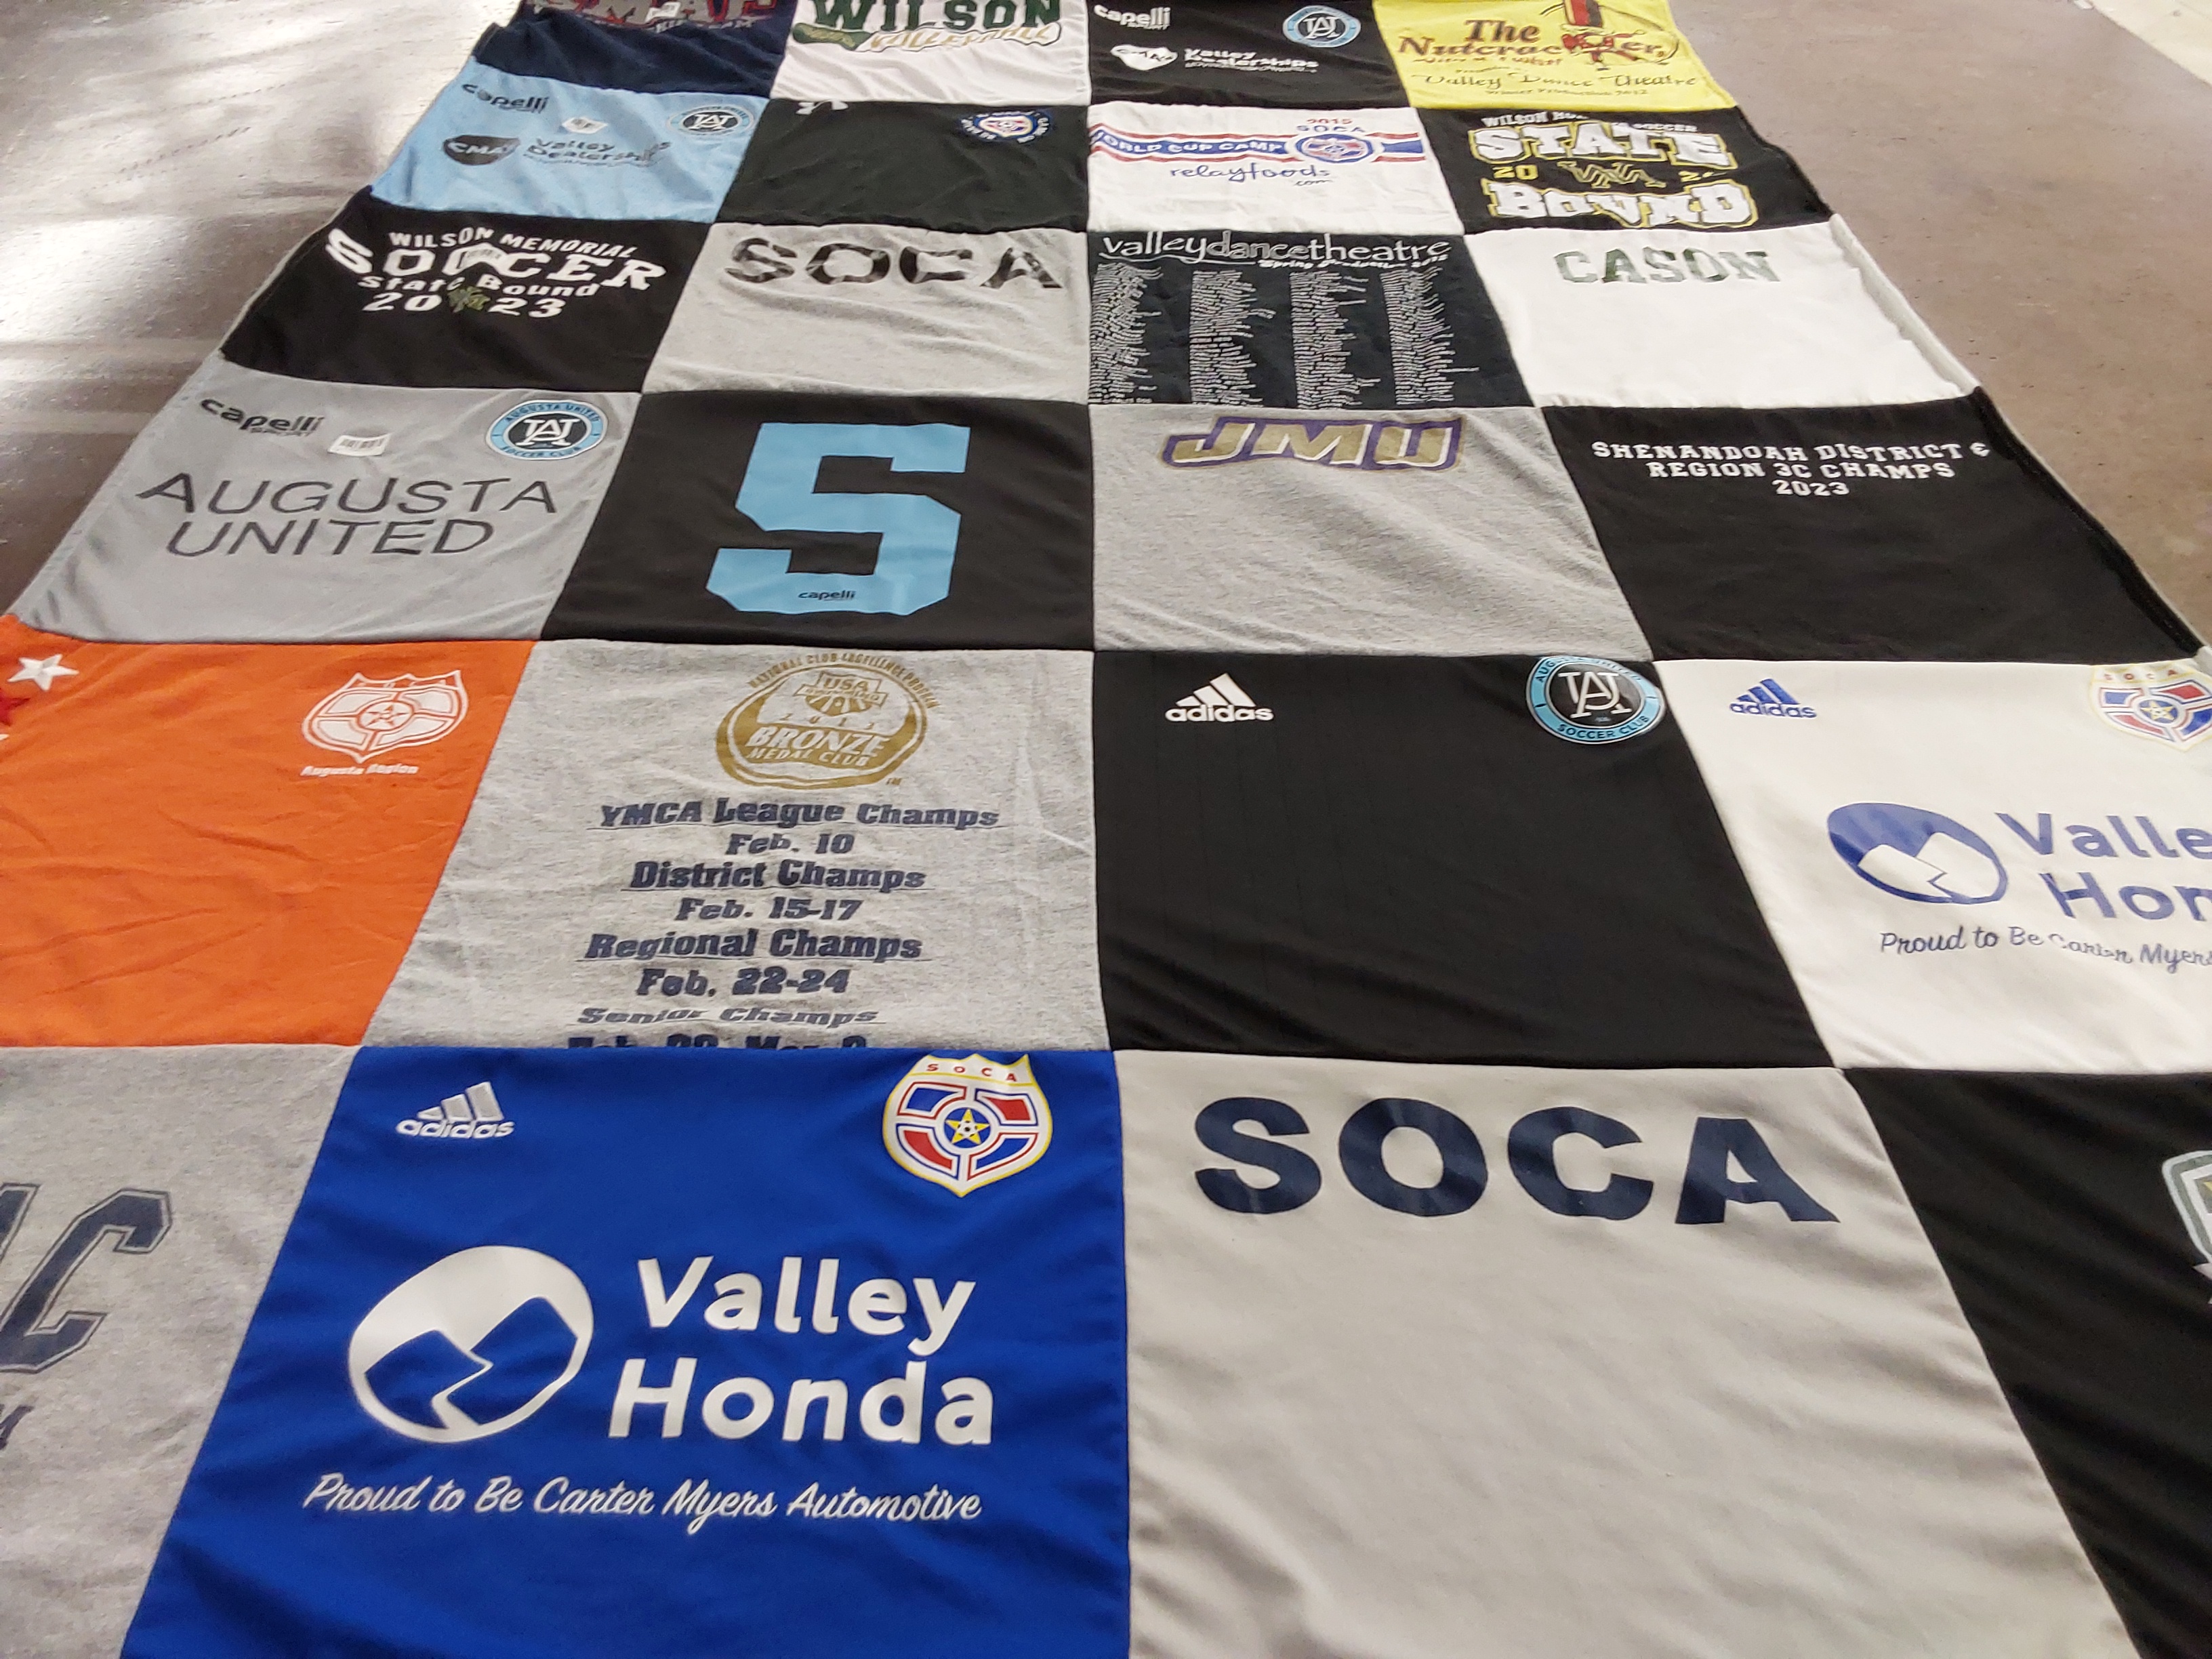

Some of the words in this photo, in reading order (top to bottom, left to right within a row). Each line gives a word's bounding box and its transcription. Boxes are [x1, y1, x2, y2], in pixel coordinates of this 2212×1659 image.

[815, 0, 1061, 30] WILSON
[1094, 5, 1171, 26] capelli
[1465, 20, 1540, 43] The
[1399, 37, 1664, 58] Nutcracer
[1411, 75, 1501, 89] Valley
[1168, 142, 1212, 153] CUP
[1219, 142, 1285, 154] CAMP
[1469, 121, 1738, 169] STATE
[1170, 163, 1330, 182] relayfoods
[1493, 165, 1538, 180] 20
[389, 226, 494, 249] WILSON
[500, 233, 638, 258] MEMORIAL
[325, 228, 667, 291] SOCCER
[725, 237, 1063, 290] SOCA
[1554, 247, 1781, 284] CASON
[477, 273, 600, 297] Bound
[363, 292, 443, 312] 20
[487, 297, 567, 318] 23
[201, 398, 325, 431] capelli
[1158, 415, 1464, 470] JMU
[1591, 441, 1809, 462] SHENANDOAH
[1814, 443, 1964, 463] DISTRICT
[1645, 462, 1766, 478] REGION
[1775, 462, 1813, 478] 3C
[1820, 462, 1956, 479] CHAMPS
[135, 472, 557, 514] AUGUSTA
[1771, 478, 1850, 497] 2023
[705, 422, 971, 616] 5
[166, 518, 495, 557] UNITED
[798, 590, 857, 600] capelli
[824, 678, 869, 691] USA
[1164, 703, 1274, 722] adidas
[1729, 701, 1817, 719] adidas
[1557, 724, 1616, 739] SOCCER
[1619, 715, 1650, 735] CLUB
[746, 726, 890, 757] BRONZE
[746, 748, 814, 760] MEDAL
[819, 752, 872, 767] CLUB
[600, 800, 703, 827] YMCA
[712, 797, 844, 828] League
[857, 803, 1000, 830] Champs
[725, 834, 800, 855] Feb.
[815, 834, 855, 855] 10
[630, 859, 768, 888] District
[777, 859, 927, 893] Champs
[674, 897, 753, 921] Feb.
[769, 897, 863, 920] 15-17
[585, 928, 759, 961] Regional
[769, 928, 923, 963] Champs
[1881, 925, 1965, 954] Proud
[1972, 926, 2000, 947] to
[2008, 926, 2044, 946] Be
[636, 967, 716, 997] Feb.
[732, 966, 852, 996] 22-24
[576, 1007, 709, 1025] Senior
[718, 1006, 879, 1029] Champs
[926, 1063, 1017, 1082] SOCA
[396, 1118, 515, 1140] adidas
[1194, 1097, 1841, 1226] SOCA
[636, 1256, 976, 1355] Valley
[608, 1357, 995, 1445] Honda
[304, 1473, 422, 1513] Proud
[428, 1479, 467, 1513] to
[474, 1475, 525, 1515] Be
[533, 1477, 657, 1516] Carter
[663, 1479, 779, 1535] Myers
[787, 1482, 983, 1523] Automotive
